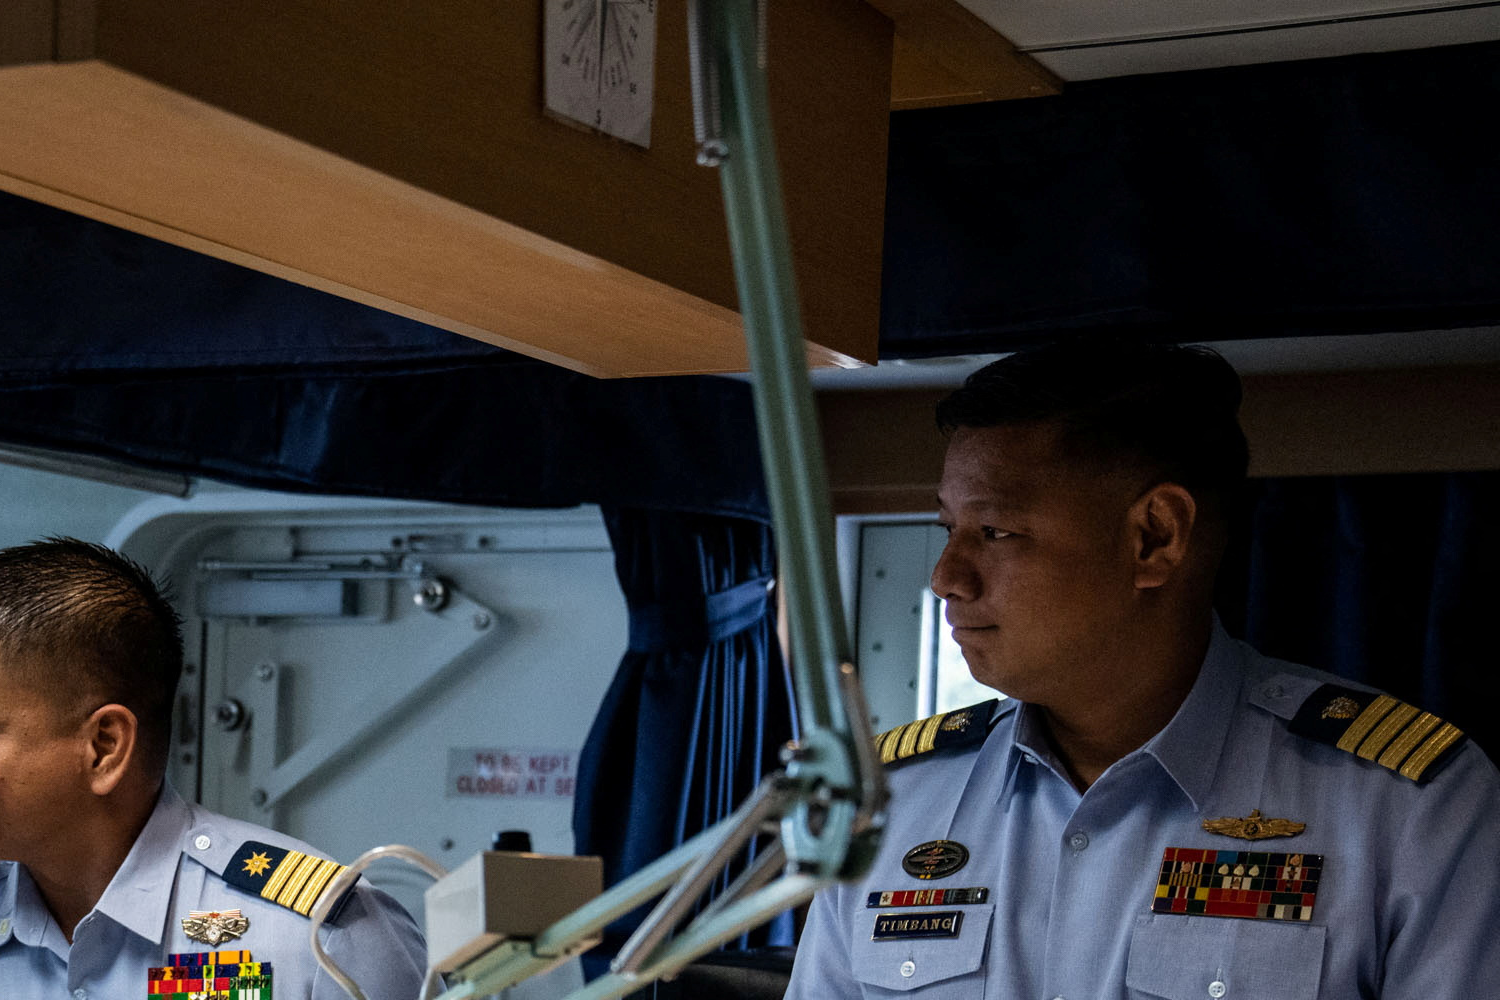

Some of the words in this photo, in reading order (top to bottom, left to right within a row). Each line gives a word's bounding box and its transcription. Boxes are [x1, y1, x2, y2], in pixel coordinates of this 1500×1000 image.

[526, 777, 546, 794] AT
[556, 778, 576, 796] SE
[879, 918, 952, 932] TIMBANG
